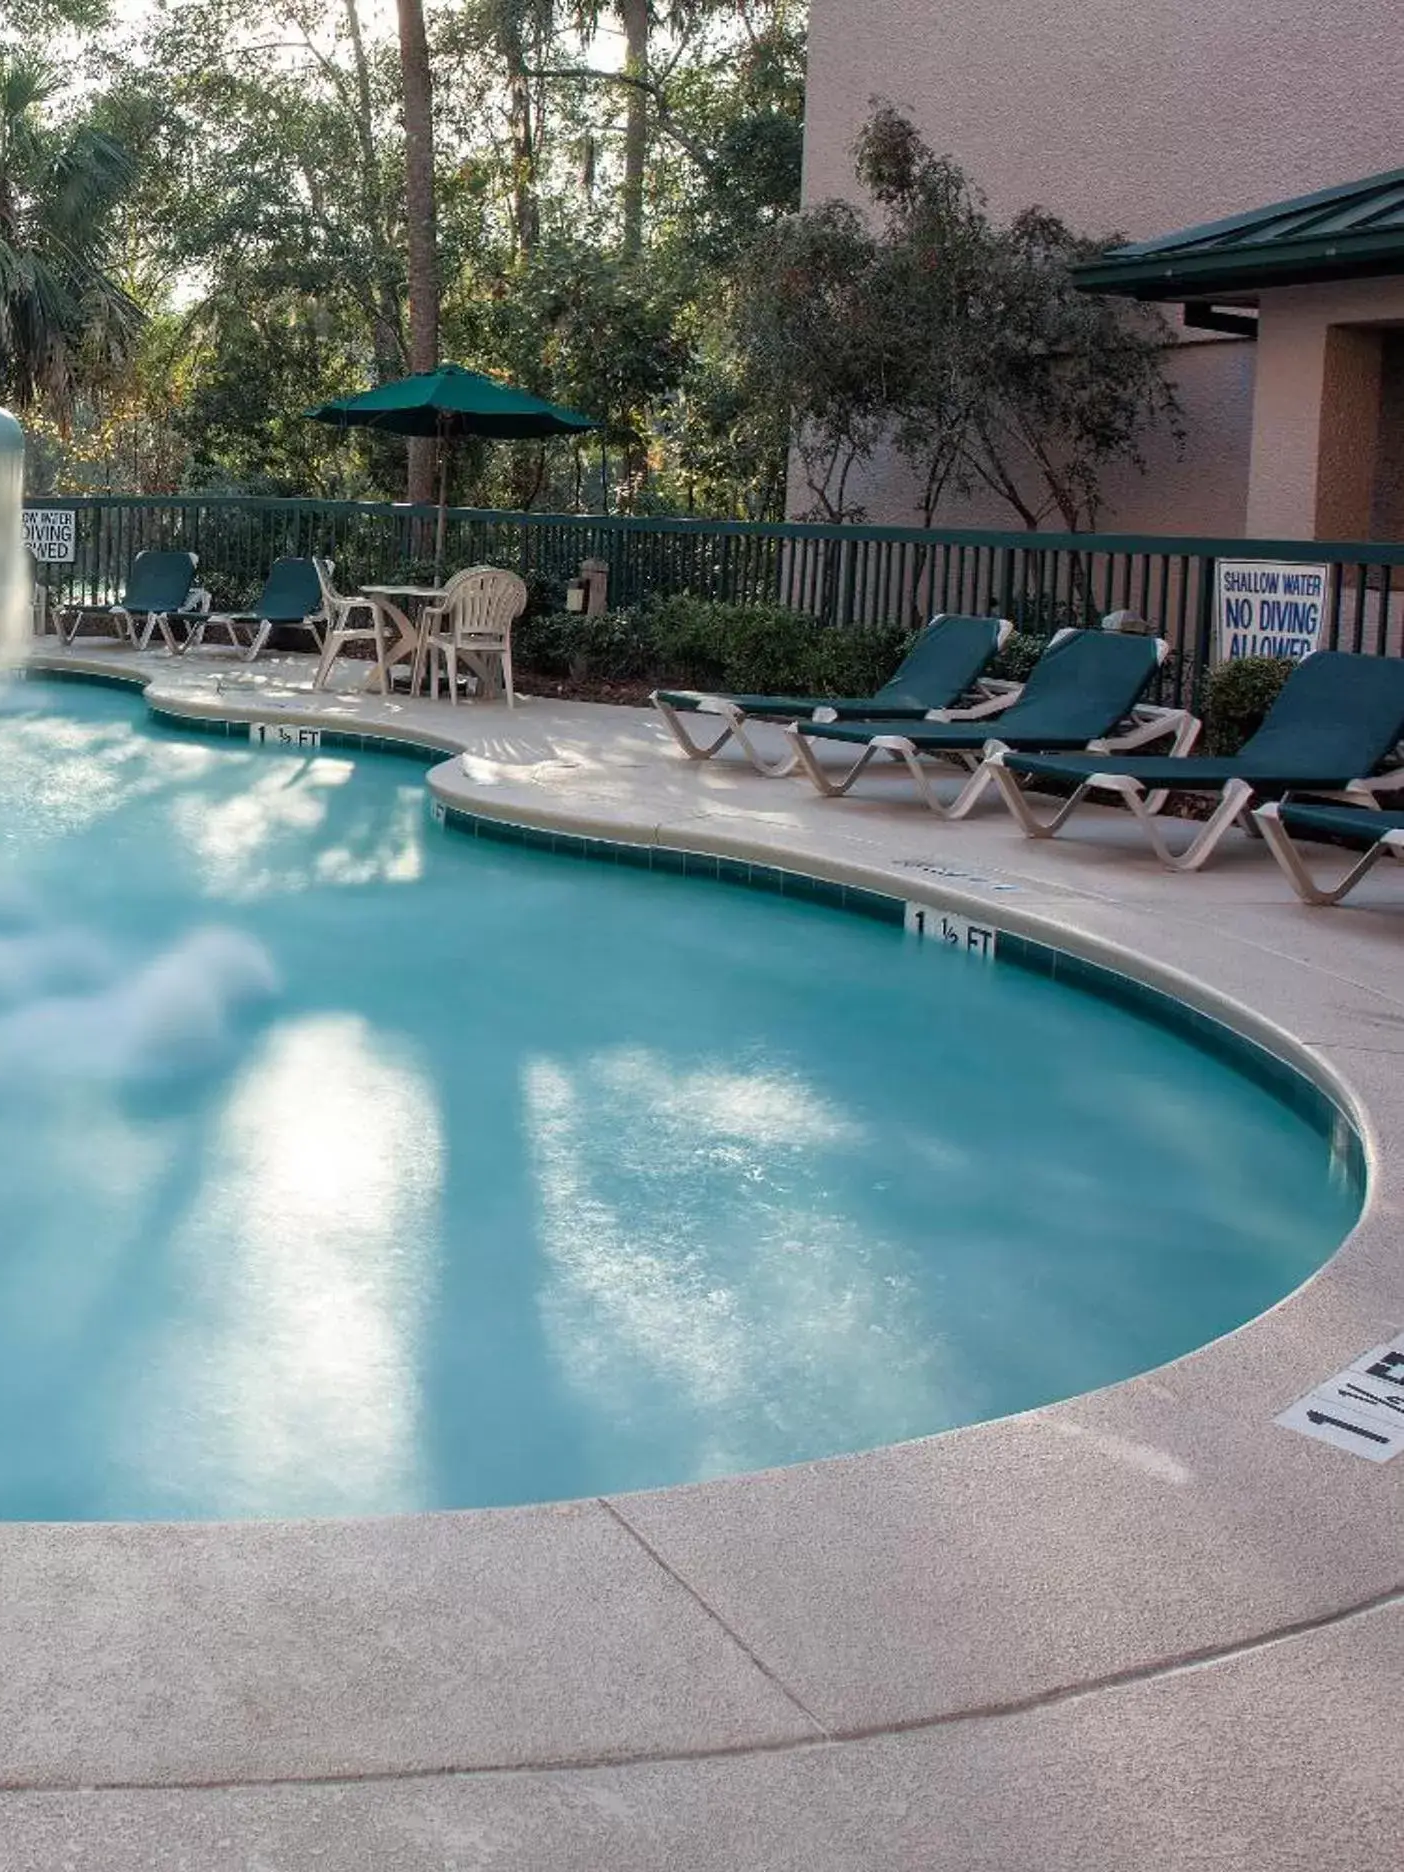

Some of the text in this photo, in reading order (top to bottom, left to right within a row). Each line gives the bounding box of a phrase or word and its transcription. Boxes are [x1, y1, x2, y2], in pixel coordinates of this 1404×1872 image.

[1224, 572, 1321, 596] SHALLOW WATER
[1226, 598, 1319, 634] NO DIVING
[258, 726, 265, 742] 1
[299, 729, 318, 747] FT
[915, 911, 924, 937] 1
[968, 926, 992, 954] FT
[1306, 1409, 1390, 1444] 1
